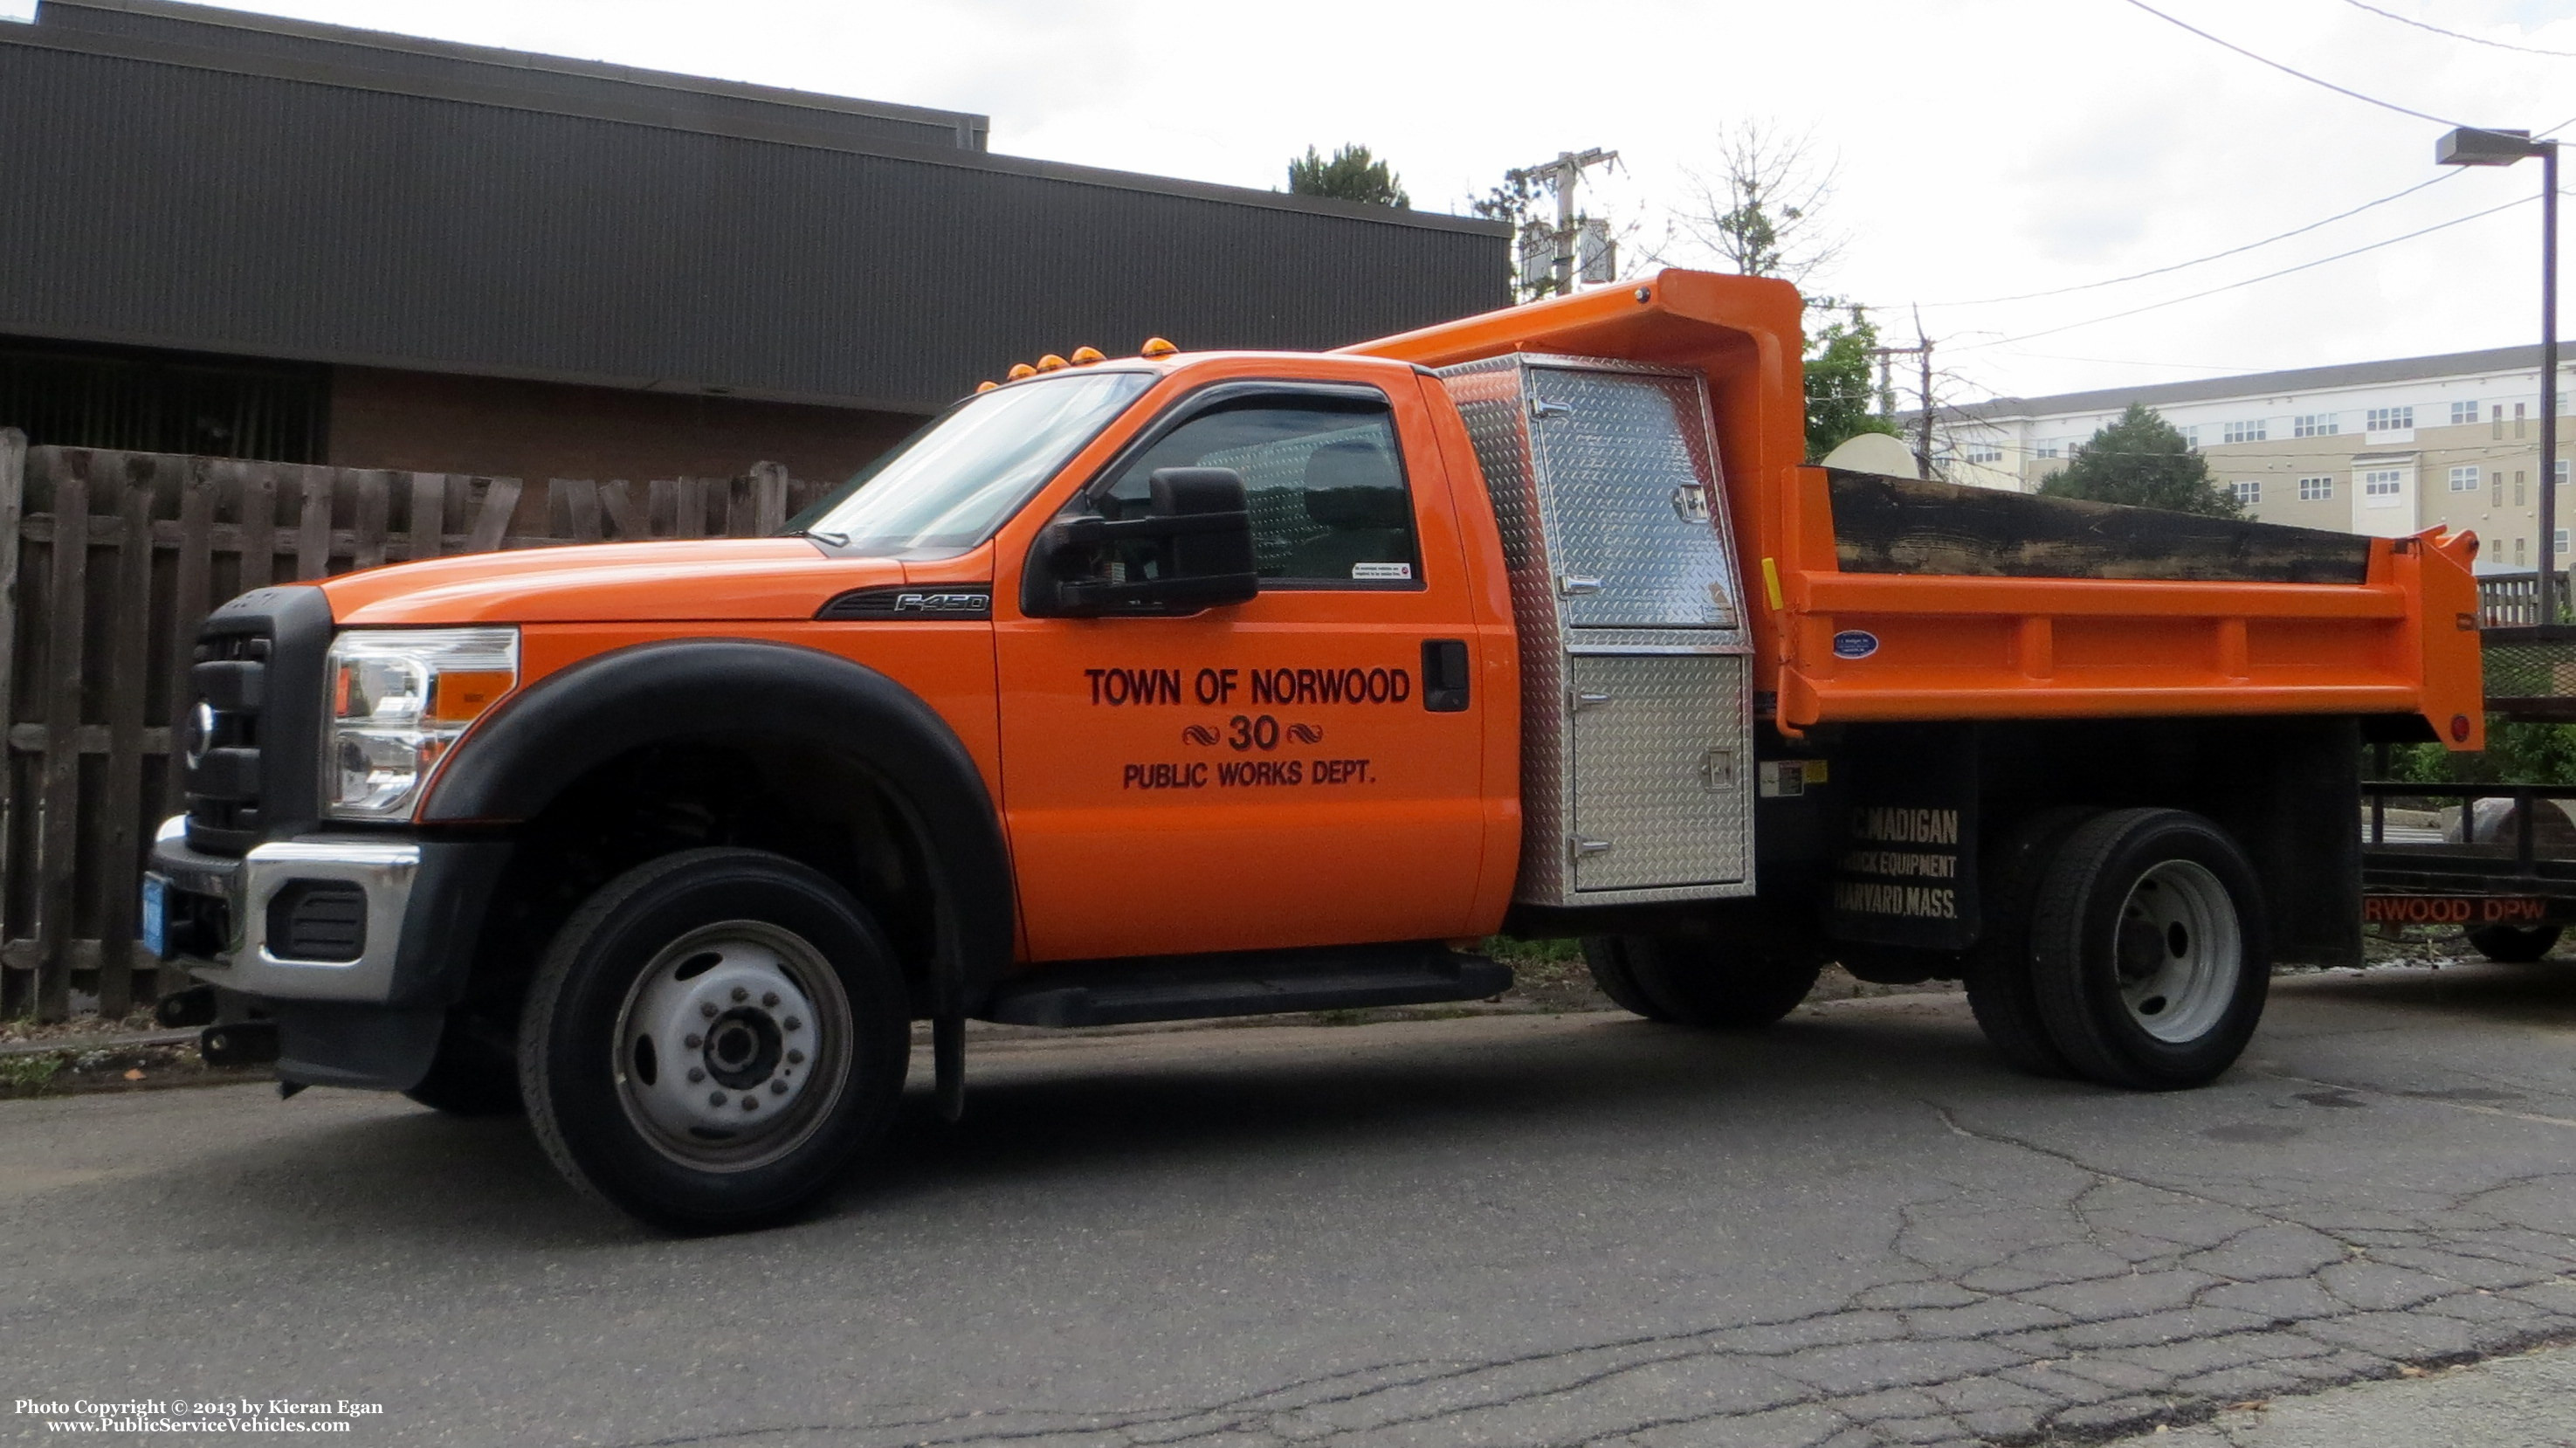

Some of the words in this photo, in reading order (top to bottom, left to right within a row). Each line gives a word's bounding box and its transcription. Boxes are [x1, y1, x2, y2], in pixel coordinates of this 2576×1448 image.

[894, 594, 989, 611] F-450
[1085, 667, 1181, 706] TOWN
[1195, 667, 1238, 705] OF
[1250, 667, 1410, 705] NORWOOD
[1229, 714, 1280, 752] 30
[1123, 762, 1209, 790] PUBLIC
[1217, 760, 1303, 787] WORKS
[1312, 759, 1376, 784] DEPT.
[1880, 852, 1957, 878] EQUIPMENT
[2483, 898, 2548, 921] DPW
